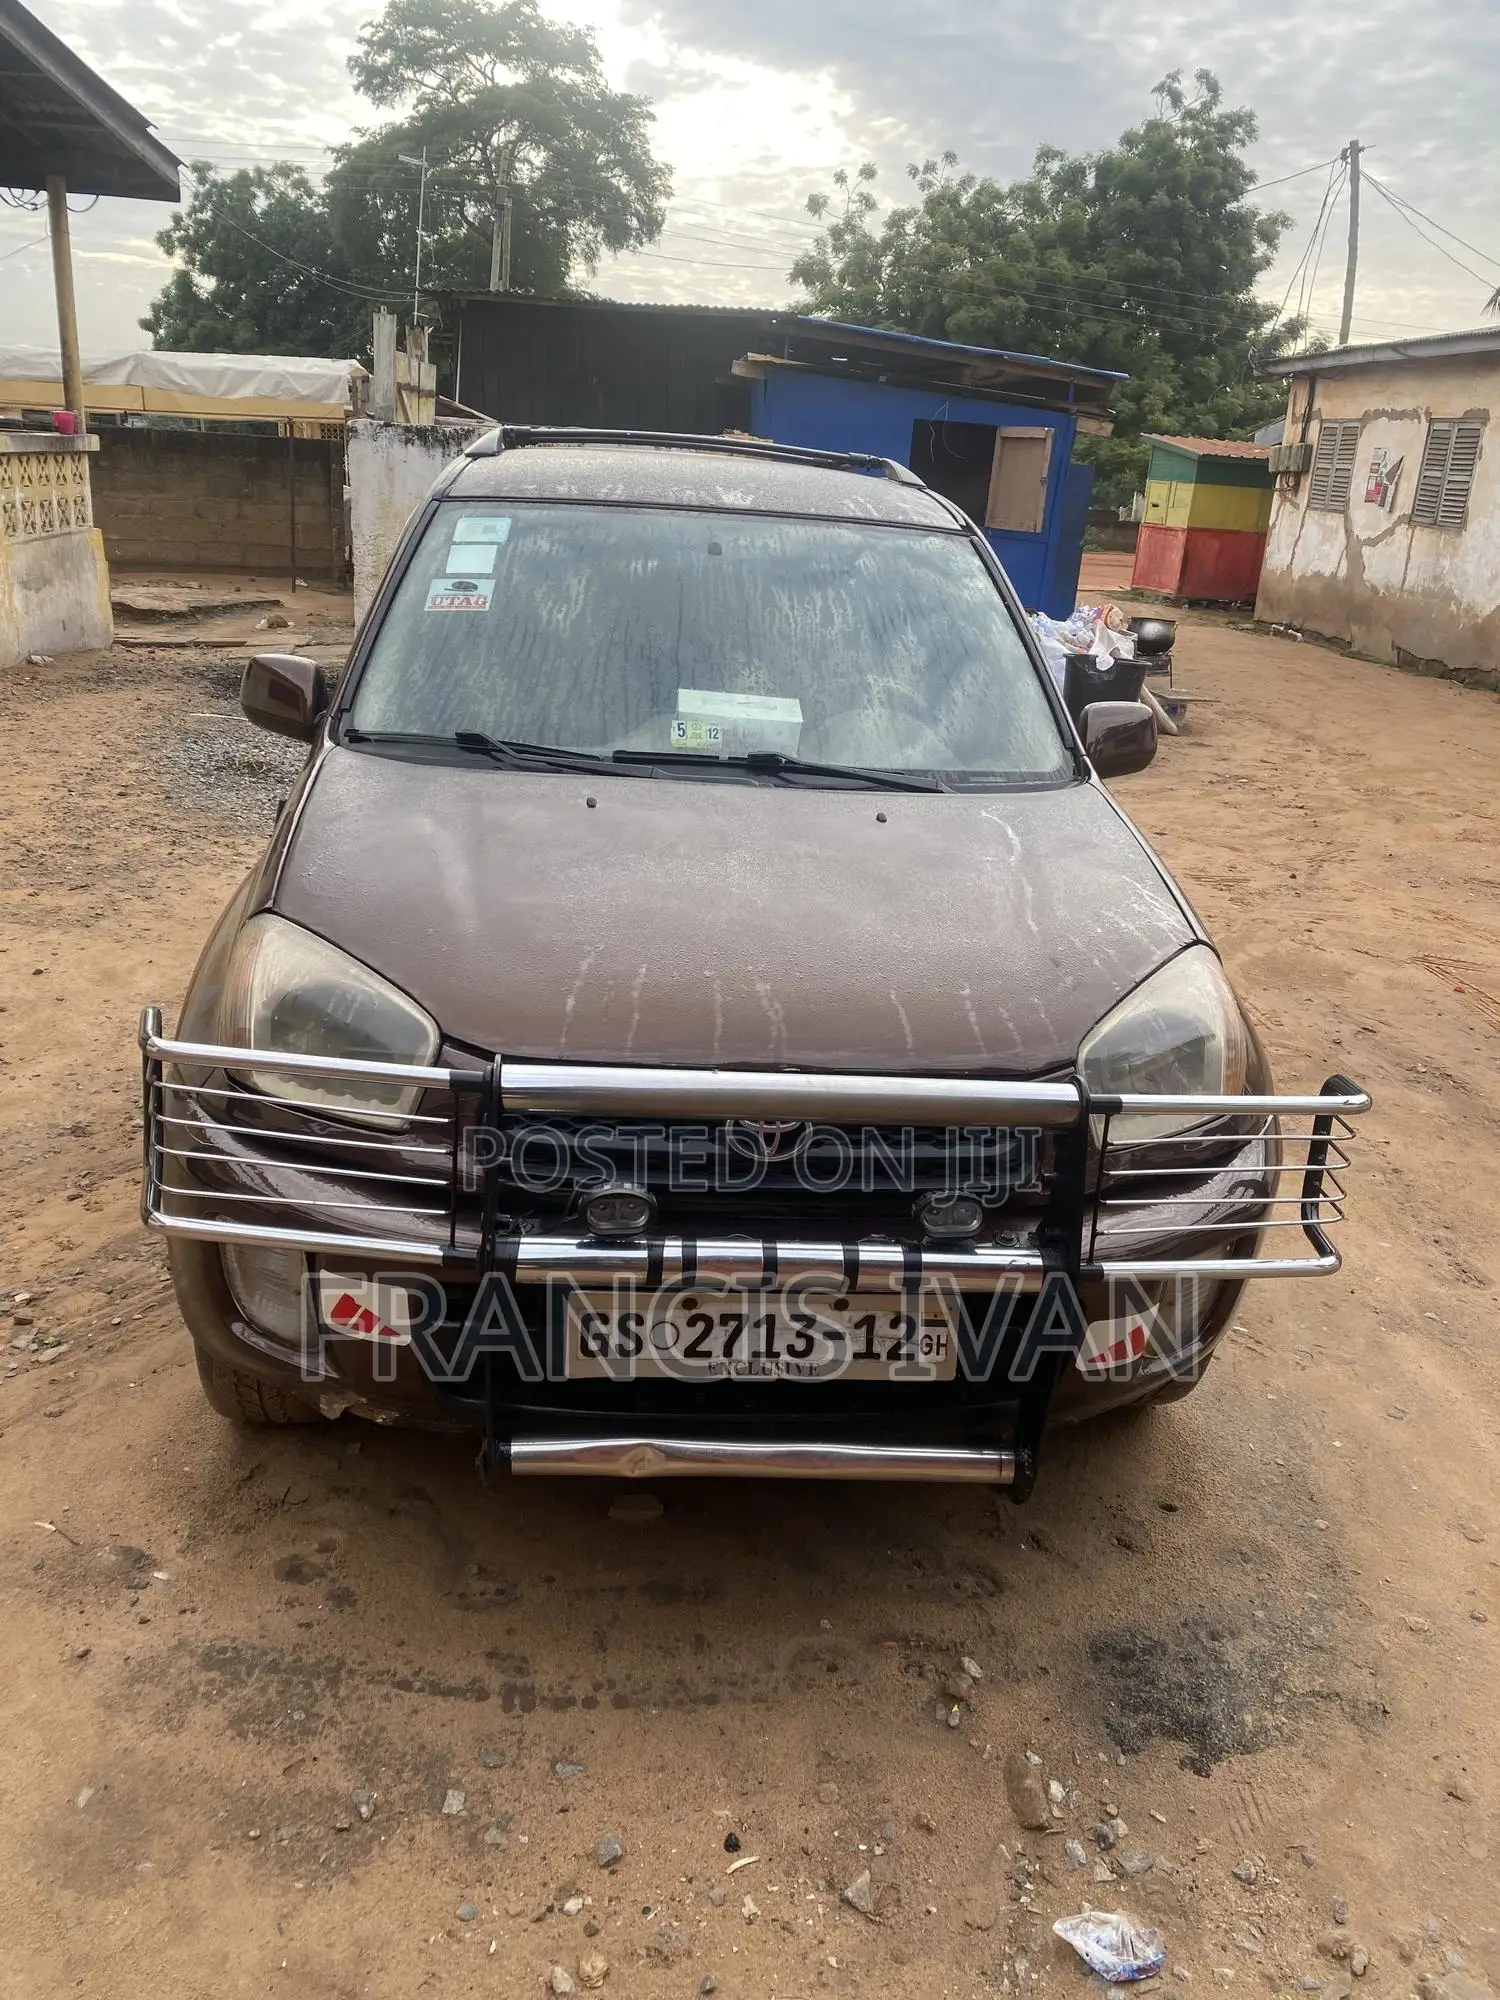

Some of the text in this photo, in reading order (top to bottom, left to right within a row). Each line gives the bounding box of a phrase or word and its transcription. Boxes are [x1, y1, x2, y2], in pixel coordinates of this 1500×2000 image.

[430, 595, 489, 606] UTAG
[677, 722, 686, 738] 5
[707, 727, 719, 740] 12
[580, 1313, 916, 1360] GS 2713-12
[920, 1334, 948, 1357] GH
[707, 1360, 820, 1378] EXCLUSIVE
